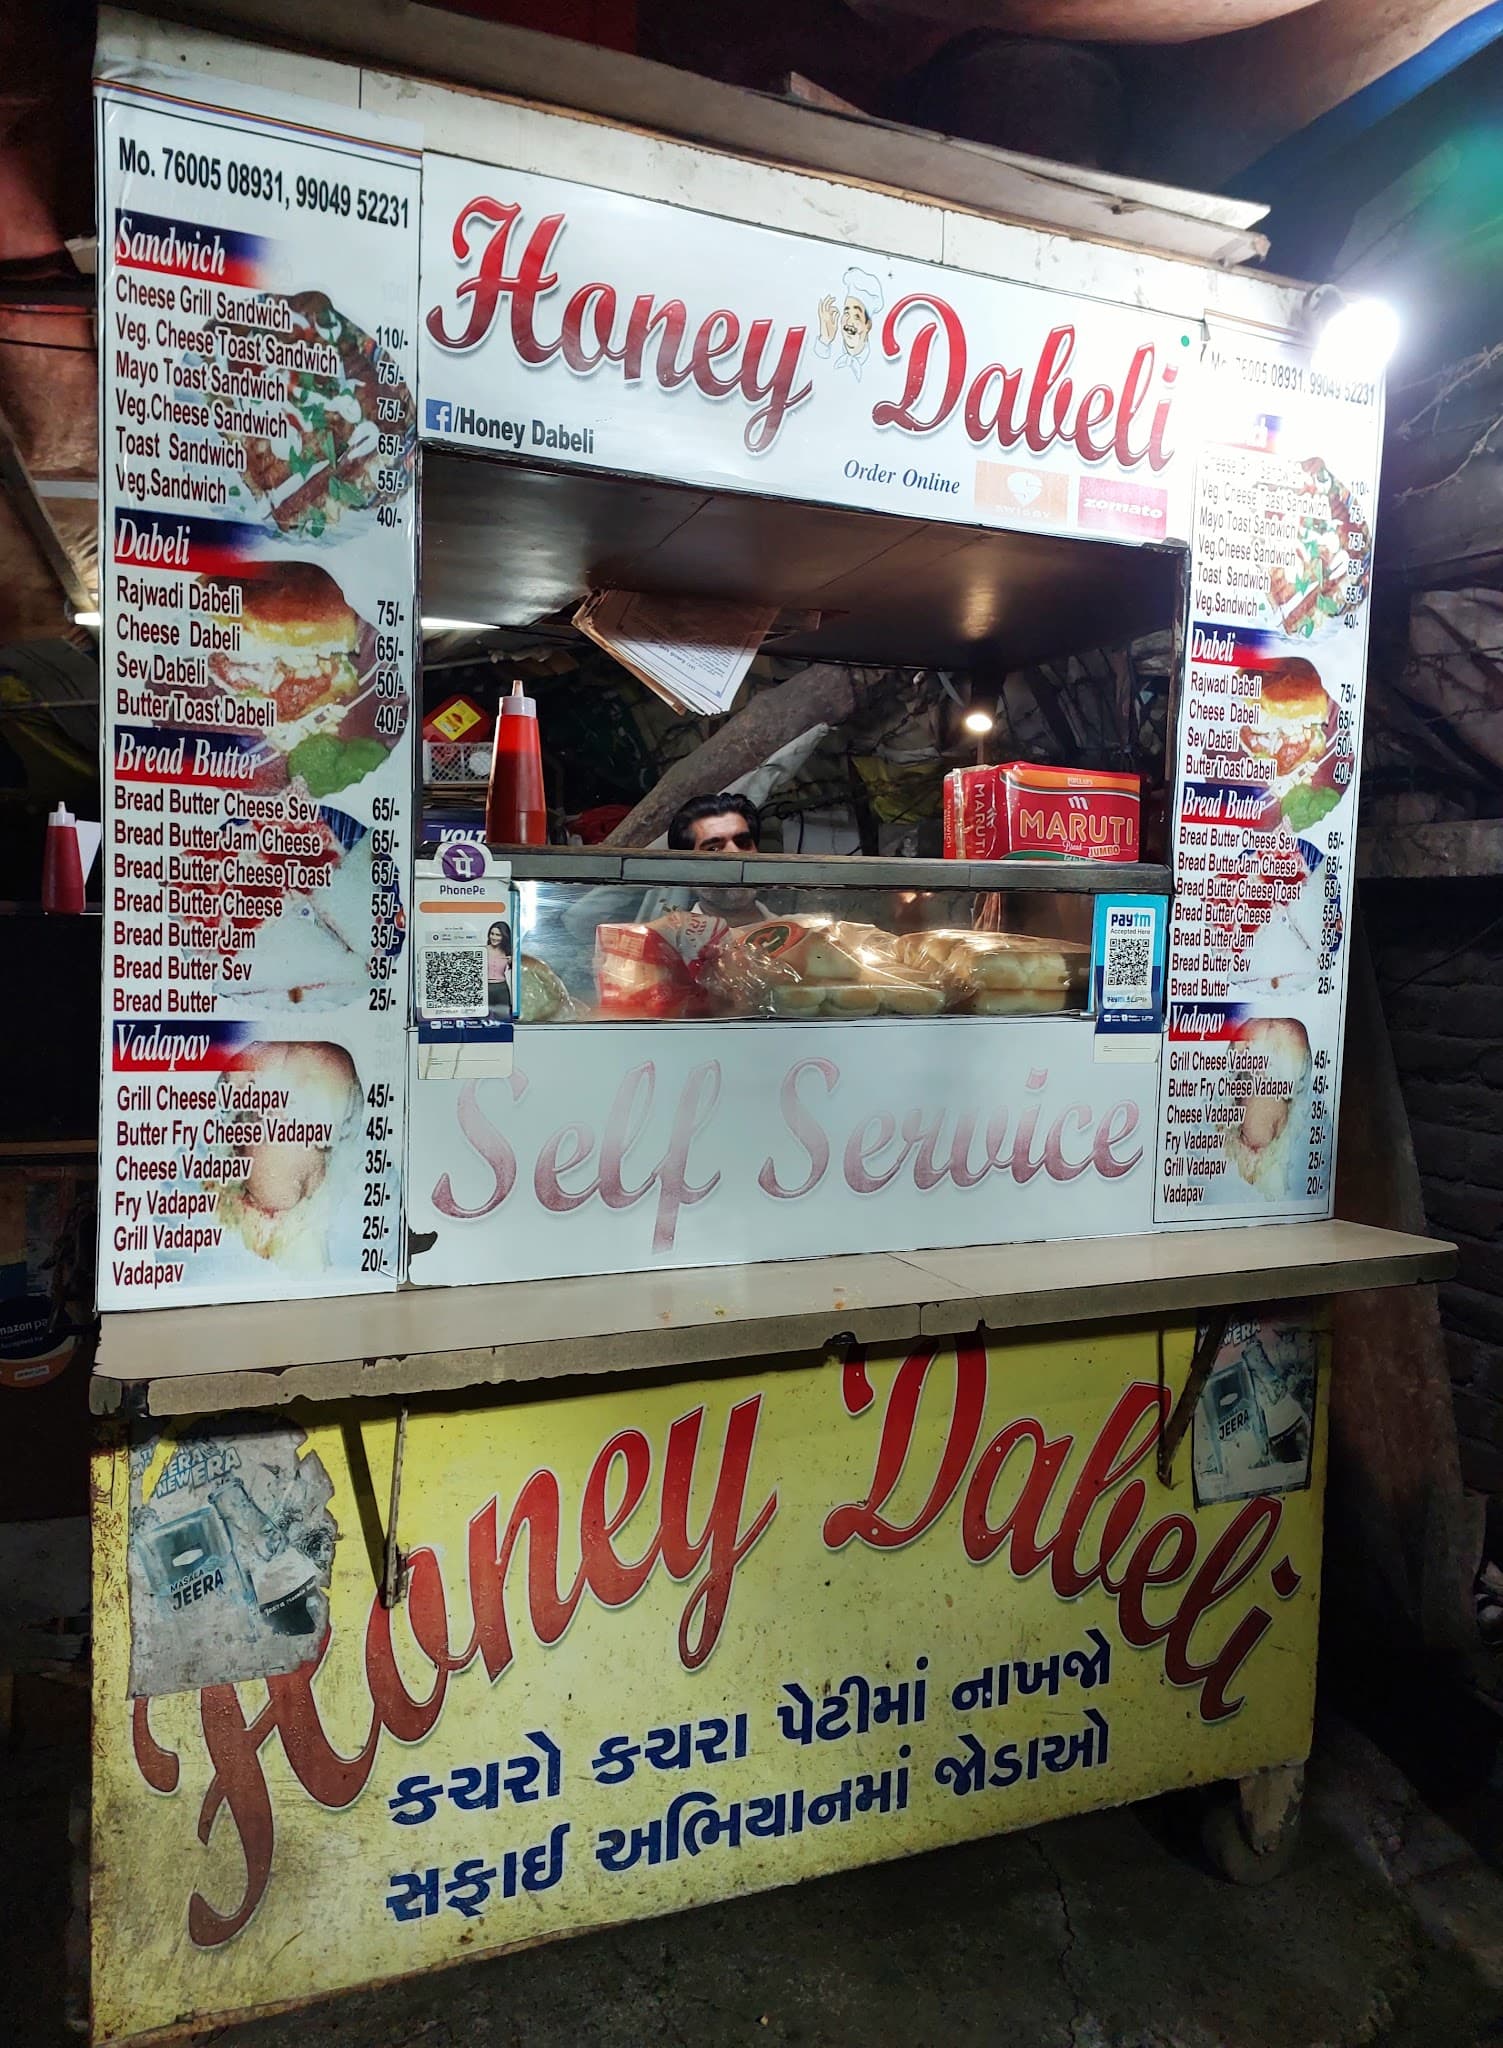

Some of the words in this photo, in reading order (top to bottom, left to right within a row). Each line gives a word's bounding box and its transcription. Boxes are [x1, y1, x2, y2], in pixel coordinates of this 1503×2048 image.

[119, 137, 155, 177] Mo.
[163, 148, 221, 191] 76005
[228, 163, 289, 209] 08931,
[296, 176, 350, 217] 99049
[357, 189, 408, 228] 52231
[116, 216, 226, 276] Sandwich
[117, 274, 175, 312] Cheese
[181, 285, 211, 315] Grill
[218, 291, 291, 330] Sandwich
[376, 325, 409, 349] 110/-
[116, 313, 150, 347] Veg.
[156, 320, 213, 354] Cheese
[219, 330, 262, 360] Toast
[265, 338, 337, 375] Sandwich
[379, 362, 405, 388] 75/-
[426, 195, 813, 454] Honey
[872, 293, 1175, 472] Dabeli
[116, 351, 158, 385] Mayo
[164, 360, 208, 390] Toast
[212, 366, 285, 402] Sandwich
[379, 398, 405, 423] 75/-
[116, 388, 209, 427] Veg.Cheese
[214, 402, 288, 439] Sandwich
[378, 434, 403, 457] 65/-
[532, 420, 594, 454] Dabeli
[116, 426, 159, 457] Toast
[169, 434, 245, 471] Sandwich
[377, 470, 403, 493] 55/-
[844, 459, 896, 485] Order
[903, 469, 960, 494] Online
[116, 464, 226, 505] Veg.Sandwich
[377, 507, 402, 529] 40/-
[1083, 498, 1163, 519] zomato
[116, 518, 191, 565] Dabeli
[117, 576, 183, 612] Rajwadi
[189, 584, 240, 615] Dabeli
[377, 600, 405, 626] 75/-
[117, 614, 180, 646] Cheese
[190, 621, 240, 651] Dabeli
[376, 636, 404, 661] 65/-
[1192, 629, 1236, 662] Dabeli
[117, 651, 148, 678] Sev
[153, 654, 206, 685] Dabeli
[376, 671, 403, 697] 50/-
[1191, 672, 1228, 697] Rajwadi
[1231, 676, 1260, 697] Dabeli
[1341, 684, 1356, 702] 75/-
[117, 689, 169, 718] Butter
[174, 693, 220, 723] Toast
[225, 699, 275, 726] Dabeli
[375, 707, 404, 733] 40/-
[116, 732, 185, 775] Bread
[192, 738, 261, 780] Butter
[114, 785, 164, 813] Bread
[170, 789, 220, 816] Butter
[224, 793, 284, 819] Cheese
[288, 797, 318, 821] Sev
[372, 798, 400, 820] 65/-
[974, 784, 986, 854] MARUTI
[1183, 787, 1223, 817] Bread
[1225, 790, 1265, 820] Butter
[114, 820, 163, 846] Bread
[170, 823, 220, 850] Butter
[223, 828, 257, 850] Jam
[262, 828, 320, 853] Cheese
[372, 830, 399, 851] 65/-
[1020, 809, 1133, 845] MARUTI
[1180, 827, 1207, 845] Bread
[1211, 828, 1239, 848] Butter
[1242, 831, 1276, 849] Cheese
[1279, 832, 1296, 849] Sev
[1328, 832, 1344, 848] 65/-
[114, 853, 163, 878] Bread
[169, 857, 219, 881] Butter
[223, 860, 283, 884] Cheese
[288, 862, 331, 887] Toast
[372, 864, 399, 884] 65/-
[1090, 846, 1120, 857] JUMBO
[114, 887, 163, 913] Bread
[169, 890, 219, 915] Butter
[223, 891, 282, 917] Cheese
[371, 894, 398, 916] 55/-
[440, 885, 485, 895] PhonePe
[114, 921, 162, 946] Bread
[169, 923, 219, 947] Butter
[222, 927, 255, 949] Jam
[370, 926, 399, 947] 35/-
[1111, 913, 1151, 927] paytm
[114, 955, 162, 979] Bread
[168, 956, 218, 980] Butter
[222, 958, 251, 981] Sev
[369, 958, 397, 980] 35/-
[113, 988, 162, 1013] Bread
[168, 989, 217, 1013] Butter
[369, 989, 397, 1011] 25/-
[1171, 979, 1199, 996] Bread
[1201, 979, 1229, 996] Butter
[1318, 978, 1334, 994] 25/-
[1172, 1005, 1225, 1040] Vadapav
[117, 1023, 210, 1072] Vadapav
[1170, 1052, 1189, 1070] Grill
[1192, 1052, 1226, 1069] Cheese
[1230, 1053, 1269, 1072] Vadapav
[1315, 1051, 1331, 1069] 45/-
[118, 1086, 151, 1110] Grill
[156, 1088, 216, 1110] Cheese
[222, 1090, 289, 1116] Vadapav
[368, 1084, 394, 1108] 45/-
[118, 1121, 168, 1146] Butter
[173, 1120, 198, 1149] Fry
[204, 1120, 262, 1143] Cheese
[267, 1118, 332, 1148] Vadapav
[366, 1117, 393, 1140] 45/-
[116, 1156, 177, 1181] Cheese
[182, 1154, 250, 1184] Vadapav
[365, 1150, 392, 1174] 35/-
[432, 1060, 721, 1254] Self
[758, 1057, 1143, 1198] Service
[116, 1191, 141, 1221] Fry
[147, 1190, 217, 1220] Vadapav
[364, 1183, 390, 1206] 25/-
[114, 1225, 147, 1250] Grill
[154, 1224, 222, 1253] Vadapav
[363, 1216, 389, 1240] 25/-
[113, 1260, 183, 1290] Vadapav
[361, 1249, 388, 1271] 20/-
[1219, 1409, 1249, 1440] JEERA
[157, 1470, 191, 1499] NEW
[192, 1447, 242, 1487] ERA
[172, 1569, 224, 1612] JEERA
[133, 1393, 777, 1947] Honey
[823, 1322, 1301, 1724] Dabeli
[388, 1730, 561, 1825] કચરો
[592, 1713, 747, 1784] કચરા
[777, 1656, 928, 1745] પેટીમાં
[952, 1628, 1111, 1711] નાખજો
[386, 1823, 570, 1921] સફાઈ
[595, 1745, 911, 1872] અભિયાનમાં
[935, 1708, 1108, 1796] જોડાઓ
